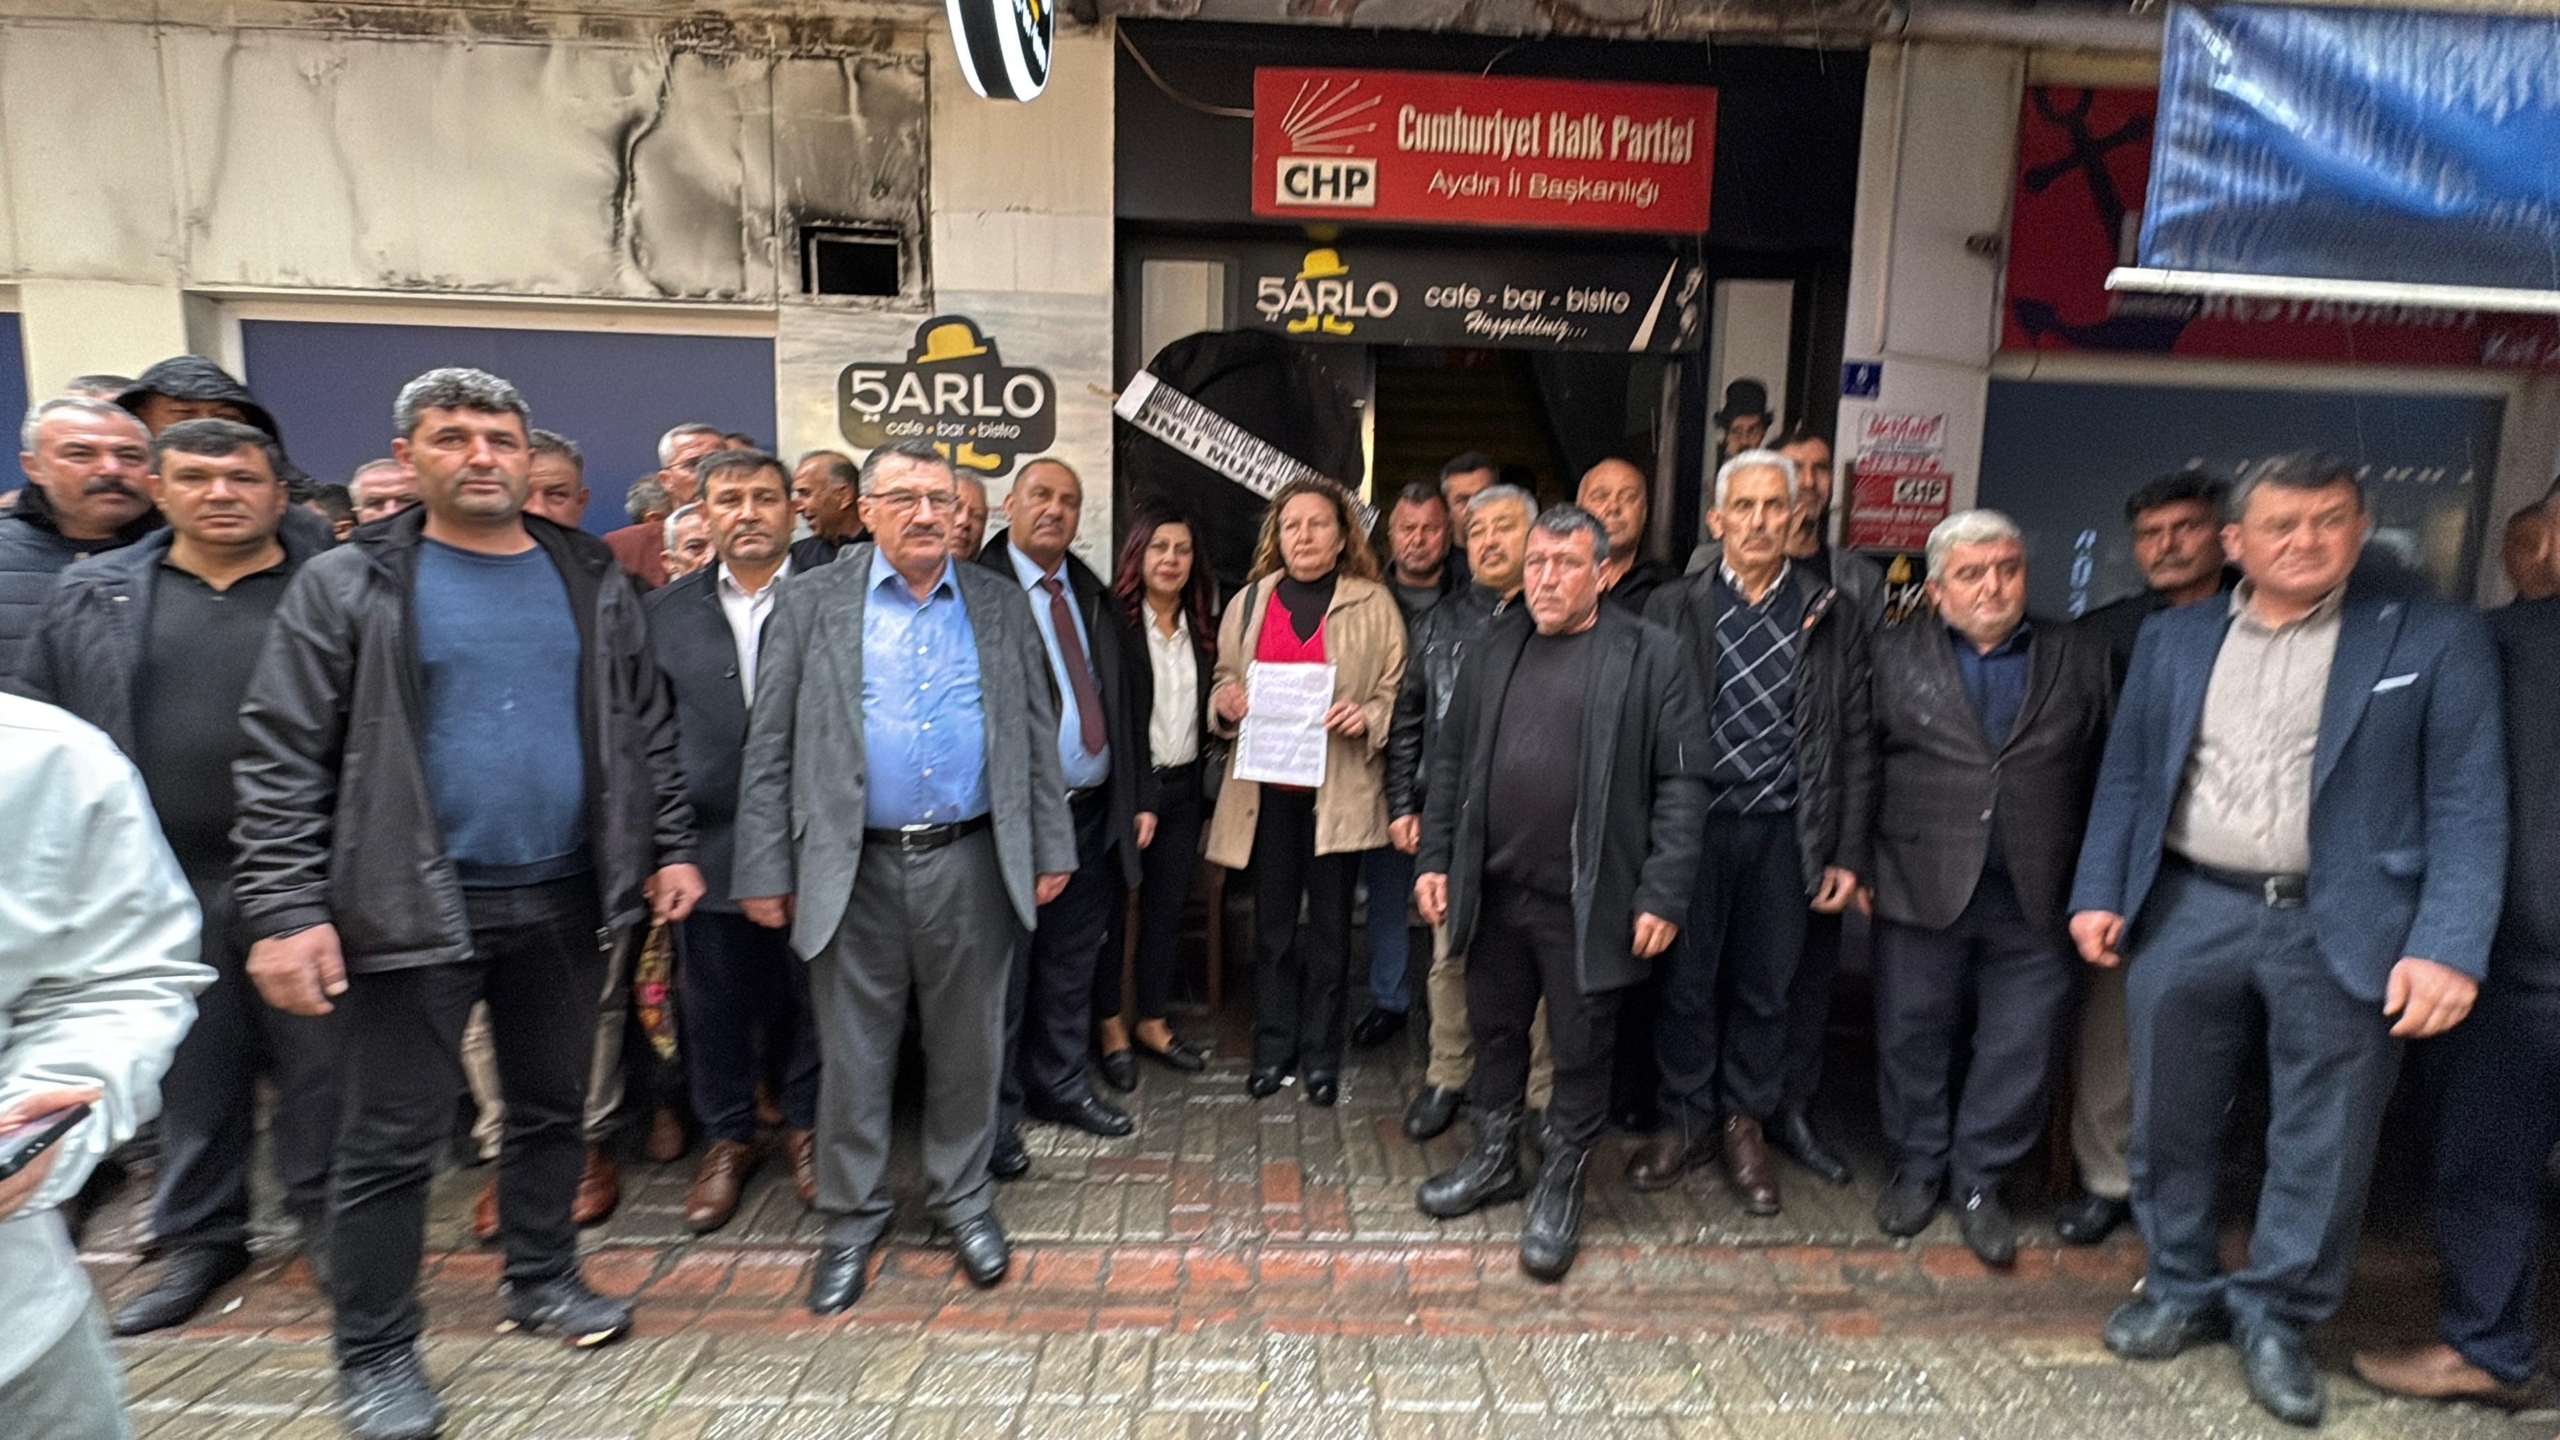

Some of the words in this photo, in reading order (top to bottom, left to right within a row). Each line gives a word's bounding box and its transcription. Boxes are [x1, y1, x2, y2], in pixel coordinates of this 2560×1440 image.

[1397, 104, 1541, 162] Cumhuriyet
[1546, 111, 1605, 161] Halk
[1609, 115, 1695, 166] Partisi
[1284, 164, 1370, 199] CHP
[1427, 168, 1500, 199] Aydın
[1528, 172, 1660, 209] Başkanlığı
[1424, 283, 1482, 309] cafe
[1502, 284, 1547, 311] bar
[1566, 286, 1631, 314] bistro
[885, 419, 925, 437] cafe
[936, 420, 965, 438] bar
[977, 421, 1021, 440] bistro
